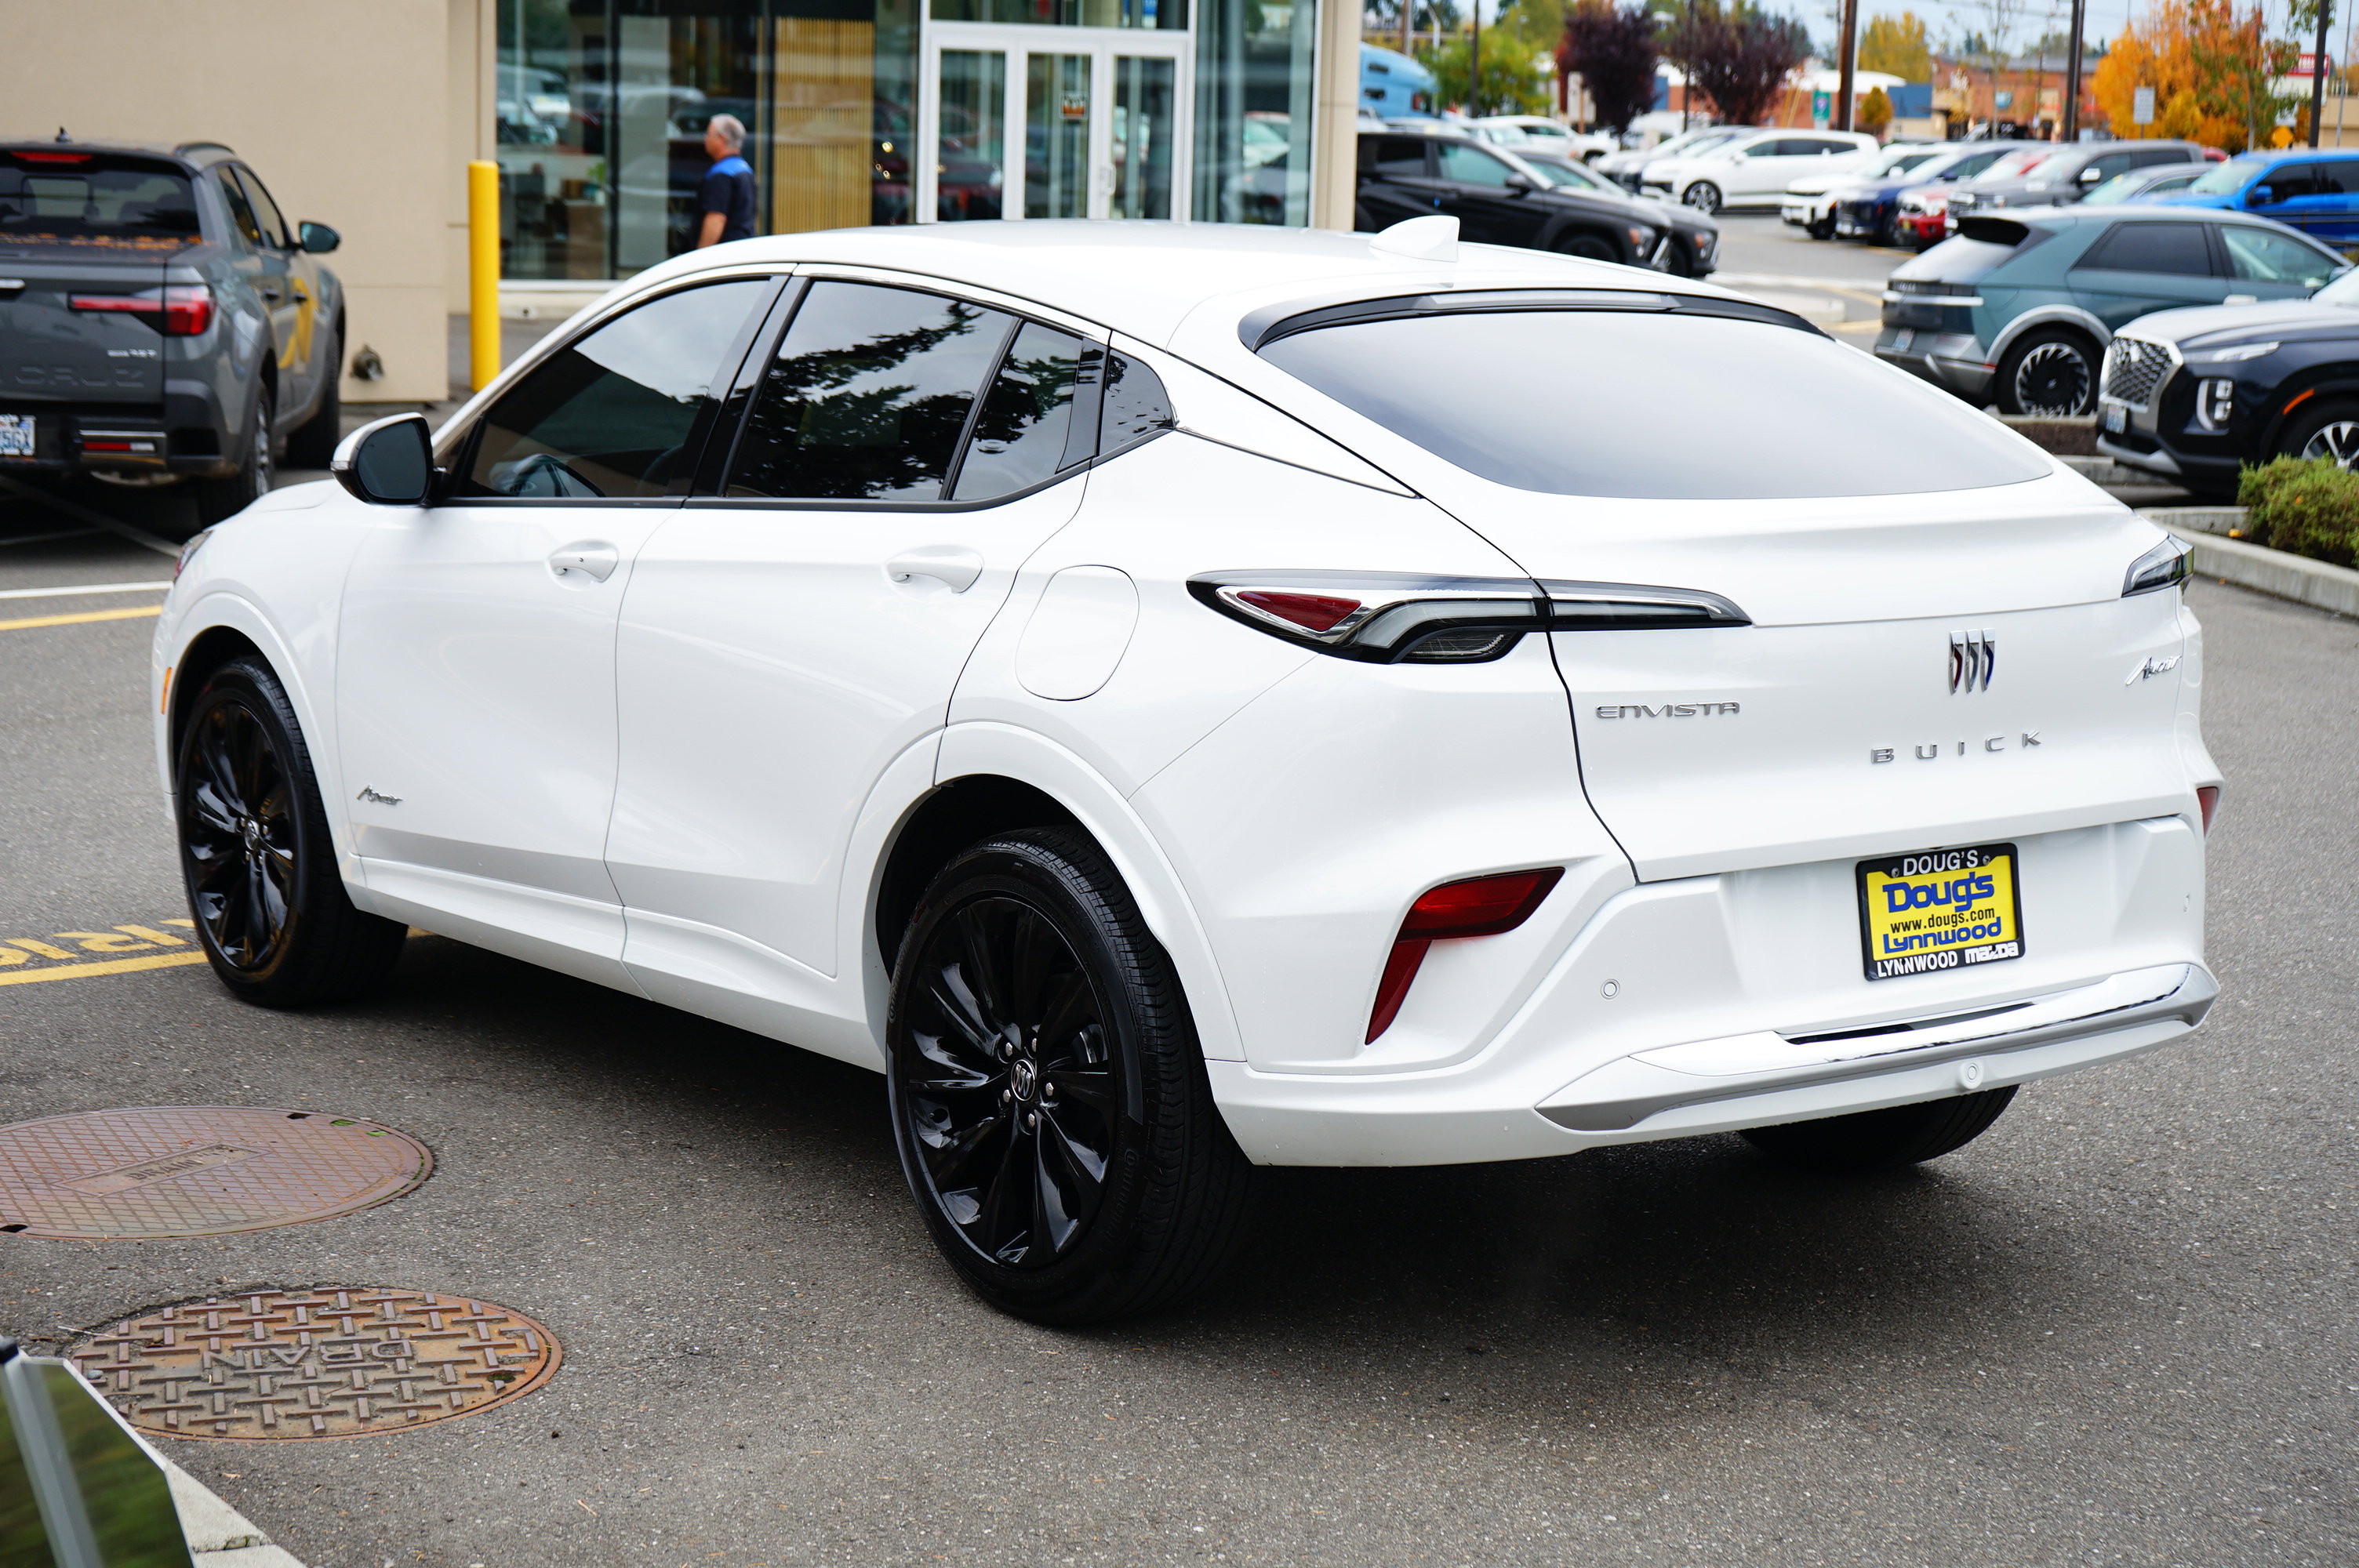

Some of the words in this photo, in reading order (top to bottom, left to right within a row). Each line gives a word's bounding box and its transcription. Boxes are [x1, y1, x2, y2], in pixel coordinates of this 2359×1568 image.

[1596, 701, 1739, 719] ENVISTA
[1871, 730, 2041, 764] BUICK
[1903, 850, 1978, 877] DOUG'S
[1882, 872, 1994, 913] Doug's
[1883, 916, 2001, 953] Lynnwood
[1891, 908, 1994, 934] www.dougs.com
[1877, 950, 1958, 978] LYNNWOOD
[202, 1339, 413, 1369] DRAIN
